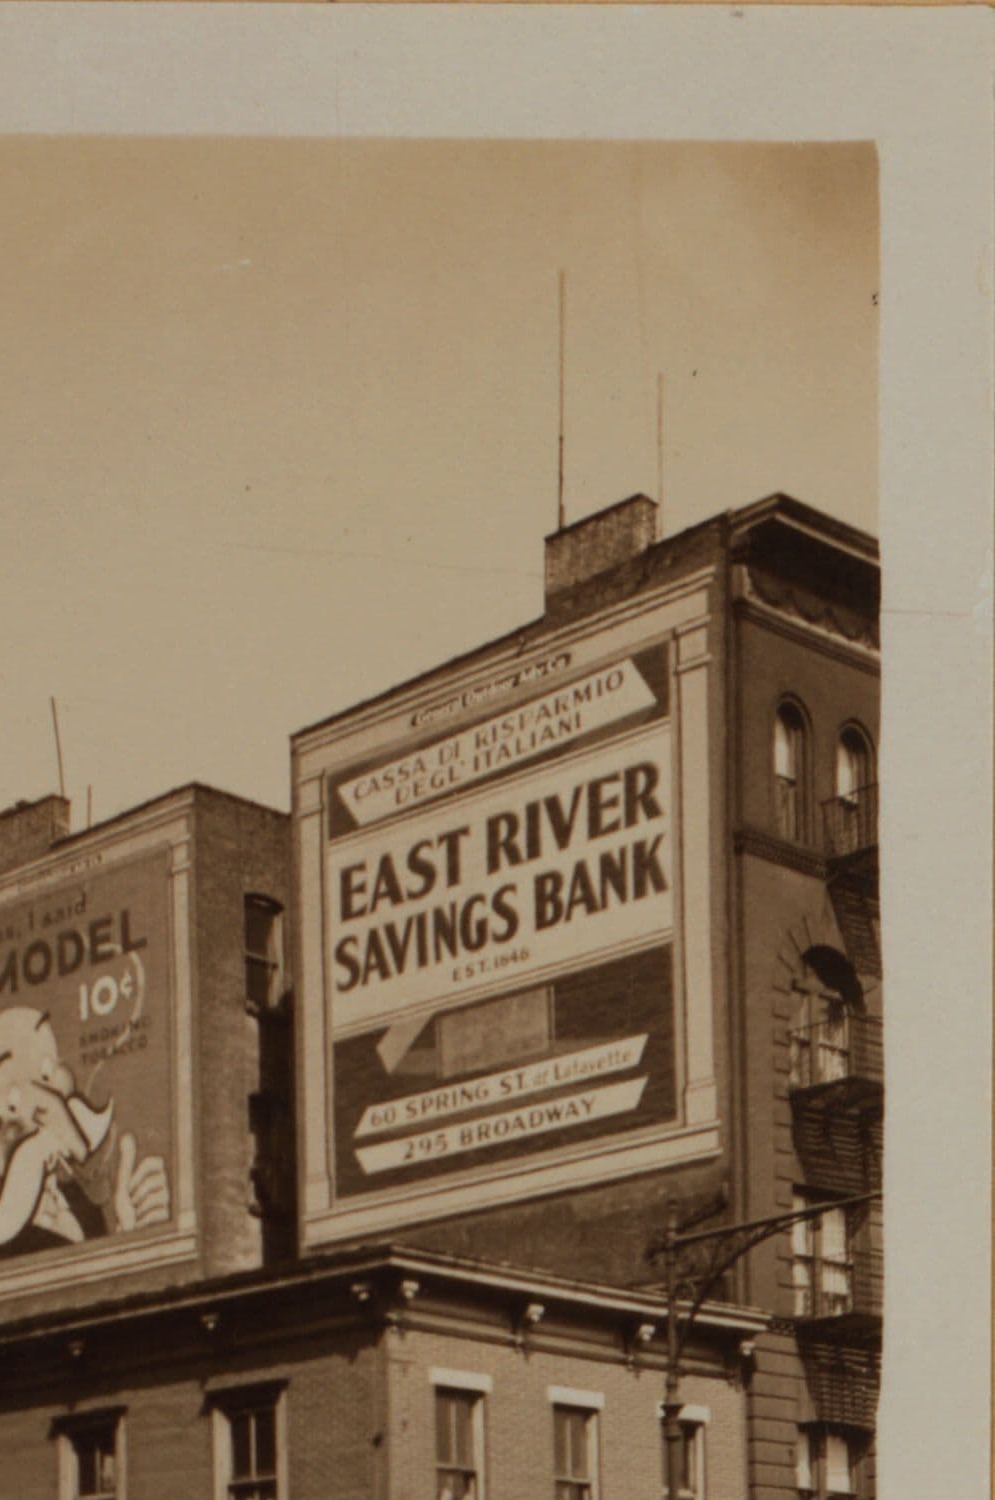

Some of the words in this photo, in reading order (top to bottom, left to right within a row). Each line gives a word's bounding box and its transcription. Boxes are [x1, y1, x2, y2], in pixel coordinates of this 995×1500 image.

[353, 761, 427, 800] CASSA
[437, 740, 461, 766] DI
[474, 669, 625, 748] RISPARMIO
[473, 712, 583, 773] ITALIANI
[339, 826, 471, 922] EAST
[485, 760, 665, 875] RIVER
[334, 885, 520, 993] SAVINGS
[533, 833, 669, 932] BANK
[370, 1107, 397, 1128] 60
[405, 1083, 490, 1120] SPRING
[403, 1132, 449, 1161] 295
[459, 1095, 597, 1147] BROADWAY
